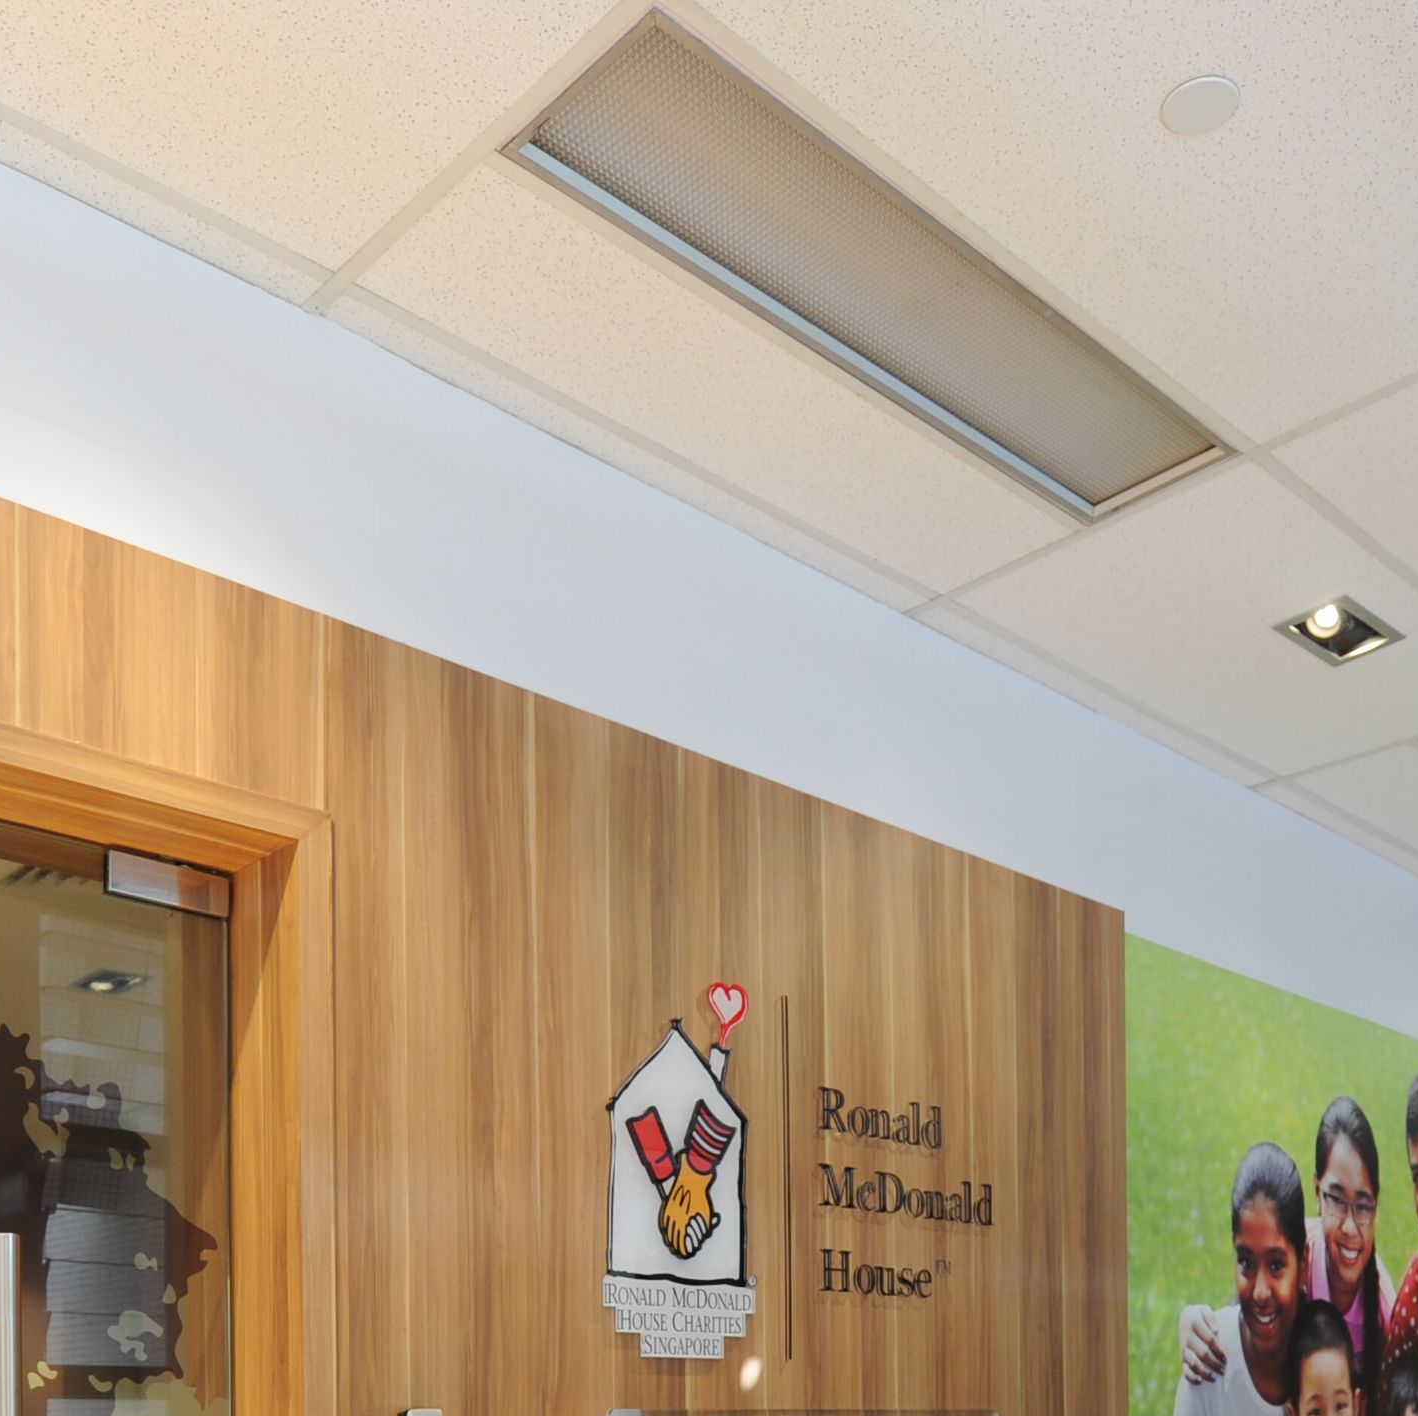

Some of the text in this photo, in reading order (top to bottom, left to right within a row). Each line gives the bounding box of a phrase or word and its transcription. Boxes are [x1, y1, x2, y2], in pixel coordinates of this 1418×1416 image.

[818, 1086, 942, 1150] Ronald
[818, 1162, 994, 1227] McDonald
[605, 1282, 666, 1308] RONALD
[617, 1309, 742, 1335] HOUSE CHARITIES
[642, 1334, 720, 1357] SINGAPORE
